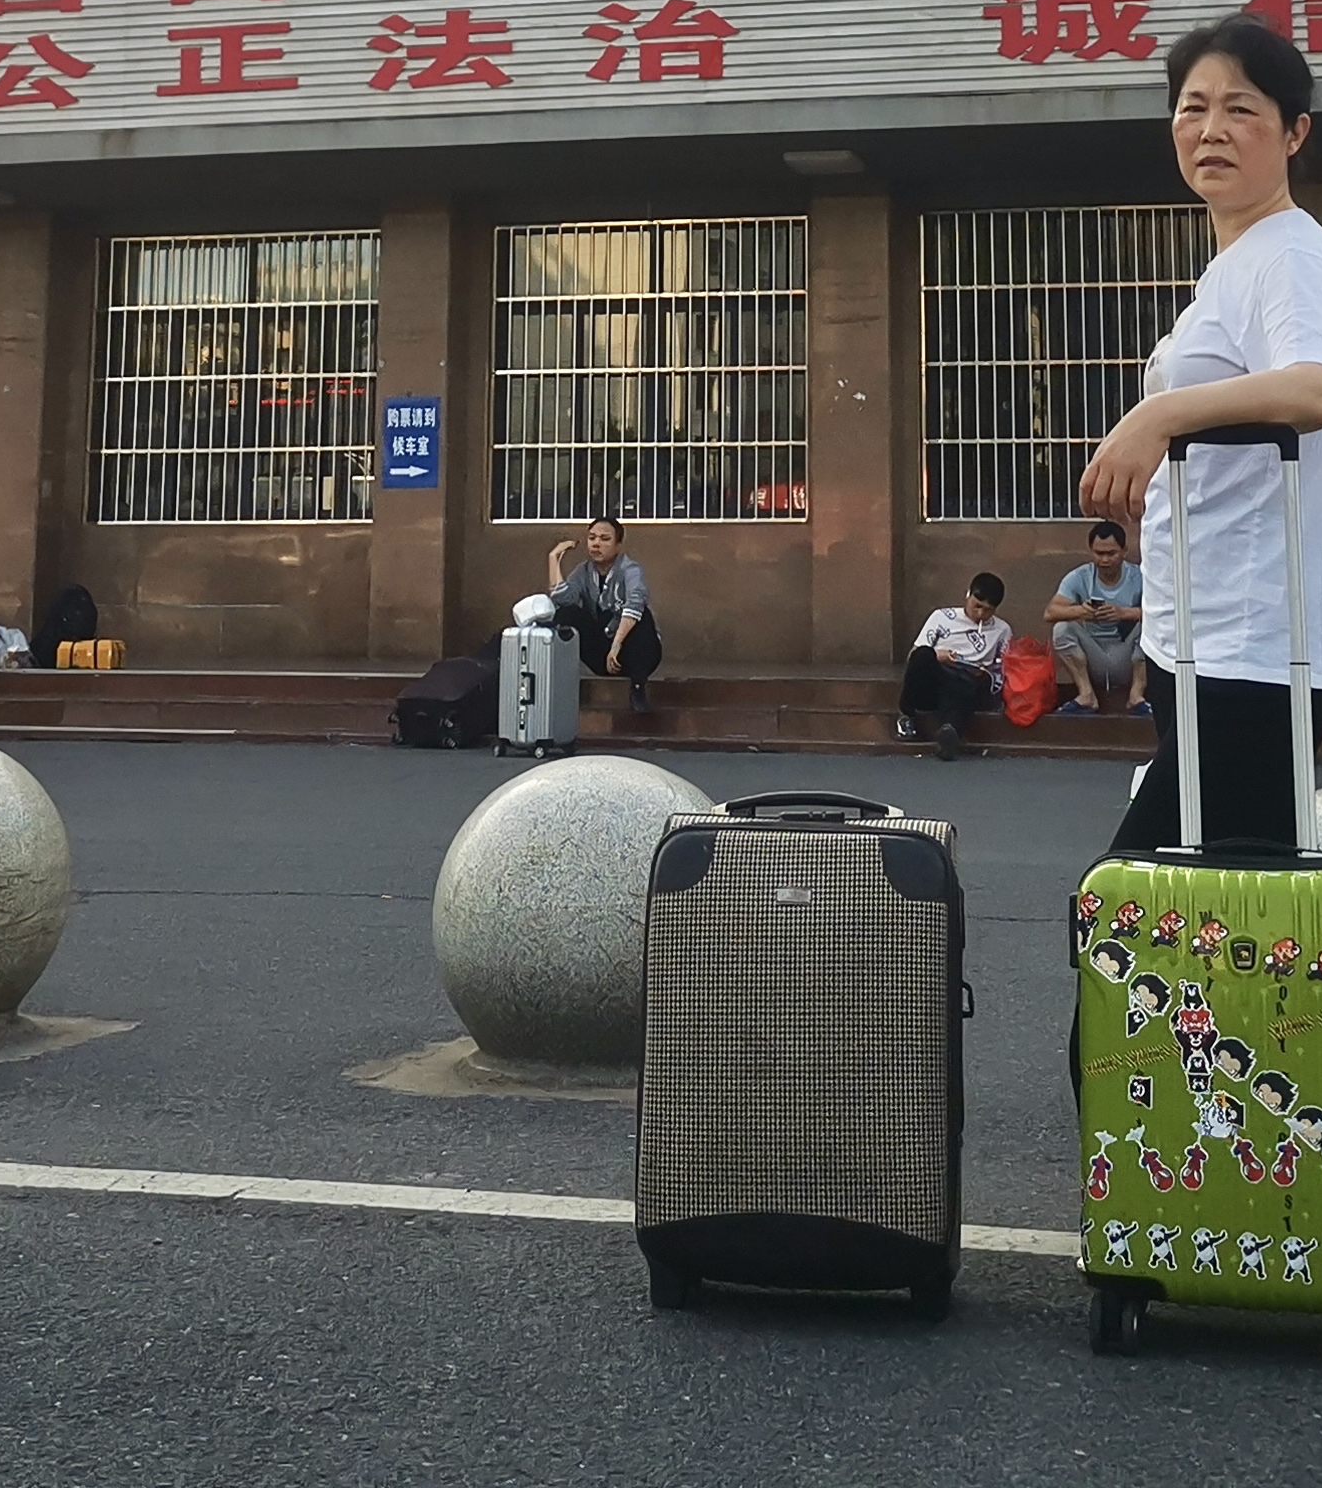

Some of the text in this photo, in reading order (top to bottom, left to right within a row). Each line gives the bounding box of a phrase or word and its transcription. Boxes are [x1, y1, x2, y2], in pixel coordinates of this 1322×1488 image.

[387, 407, 436, 428] 购票请到
[392, 435, 429, 456] 候车室
